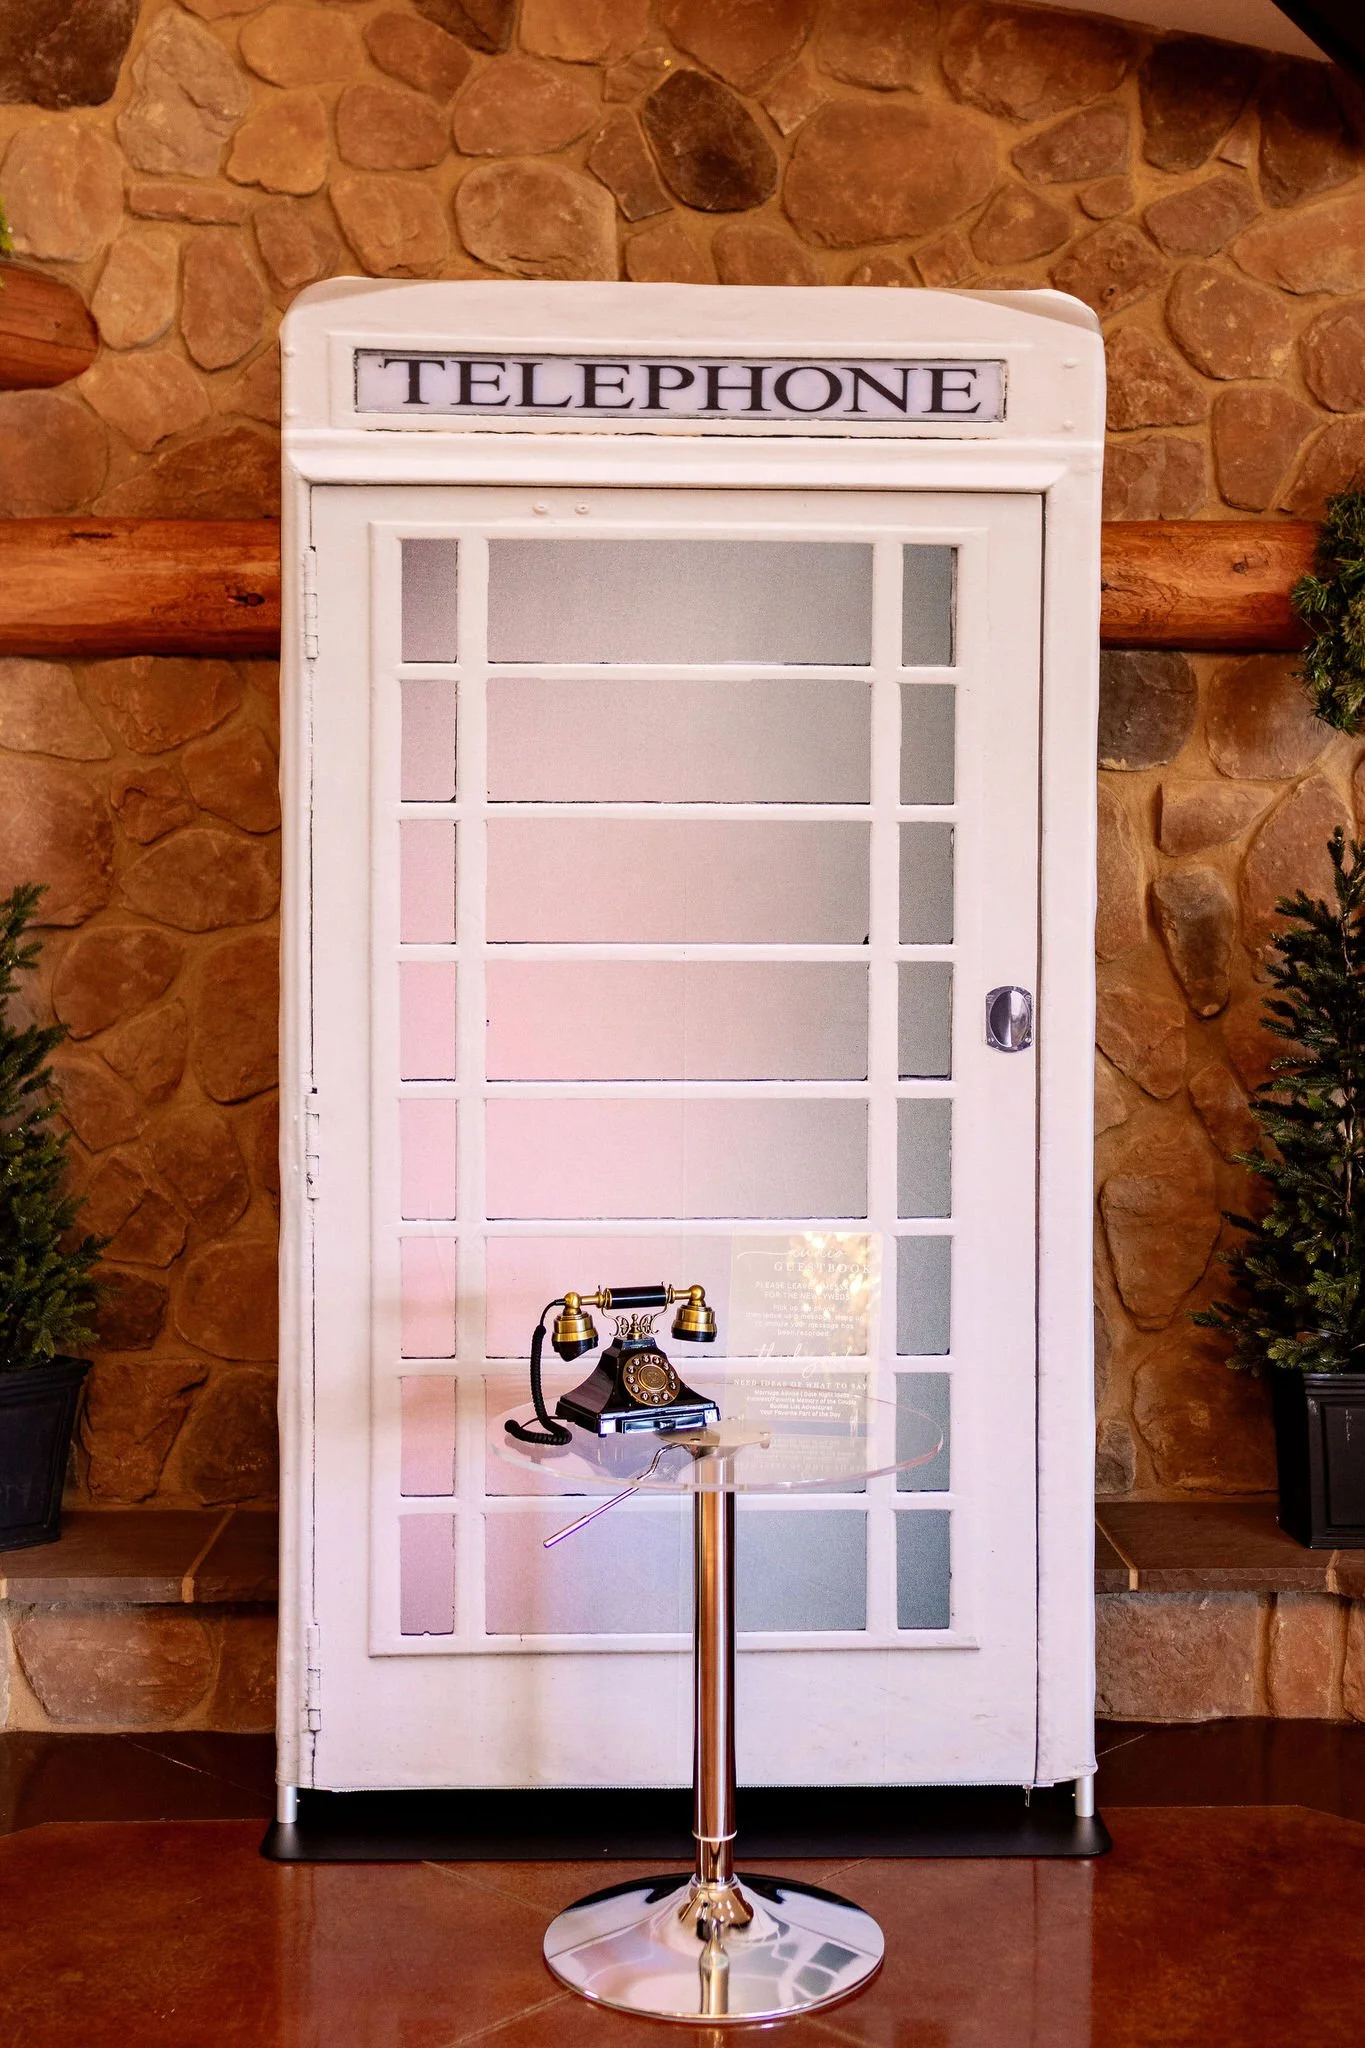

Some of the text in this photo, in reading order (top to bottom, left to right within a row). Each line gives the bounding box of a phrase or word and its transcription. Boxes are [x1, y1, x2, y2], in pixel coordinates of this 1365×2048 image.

[383, 357, 982, 414] TELEPHONE
[774, 1262, 873, 1274] GUESTBOOK
[755, 1281, 785, 1289] PLEASE
[764, 1291, 781, 1299] FOR
[783, 1291, 799, 1300] THE
[808, 1322, 839, 1330] message
[777, 1329, 795, 1337] been
[734, 1379, 757, 1387] NEED
[760, 1380, 787, 1388] IDEAS
[790, 1381, 802, 1389] OF
[805, 1382, 832, 1390] WHAT
[803, 1391, 817, 1399] Date
[818, 1392, 834, 1400] Night
[796, 1397, 819, 1405] Memory
[837, 1399, 857, 1407] Couple
[790, 1403, 800, 1411] List
[774, 1409, 798, 1417] Favorite
[819, 1410, 828, 1418] the
[829, 1411, 841, 1419] Day
